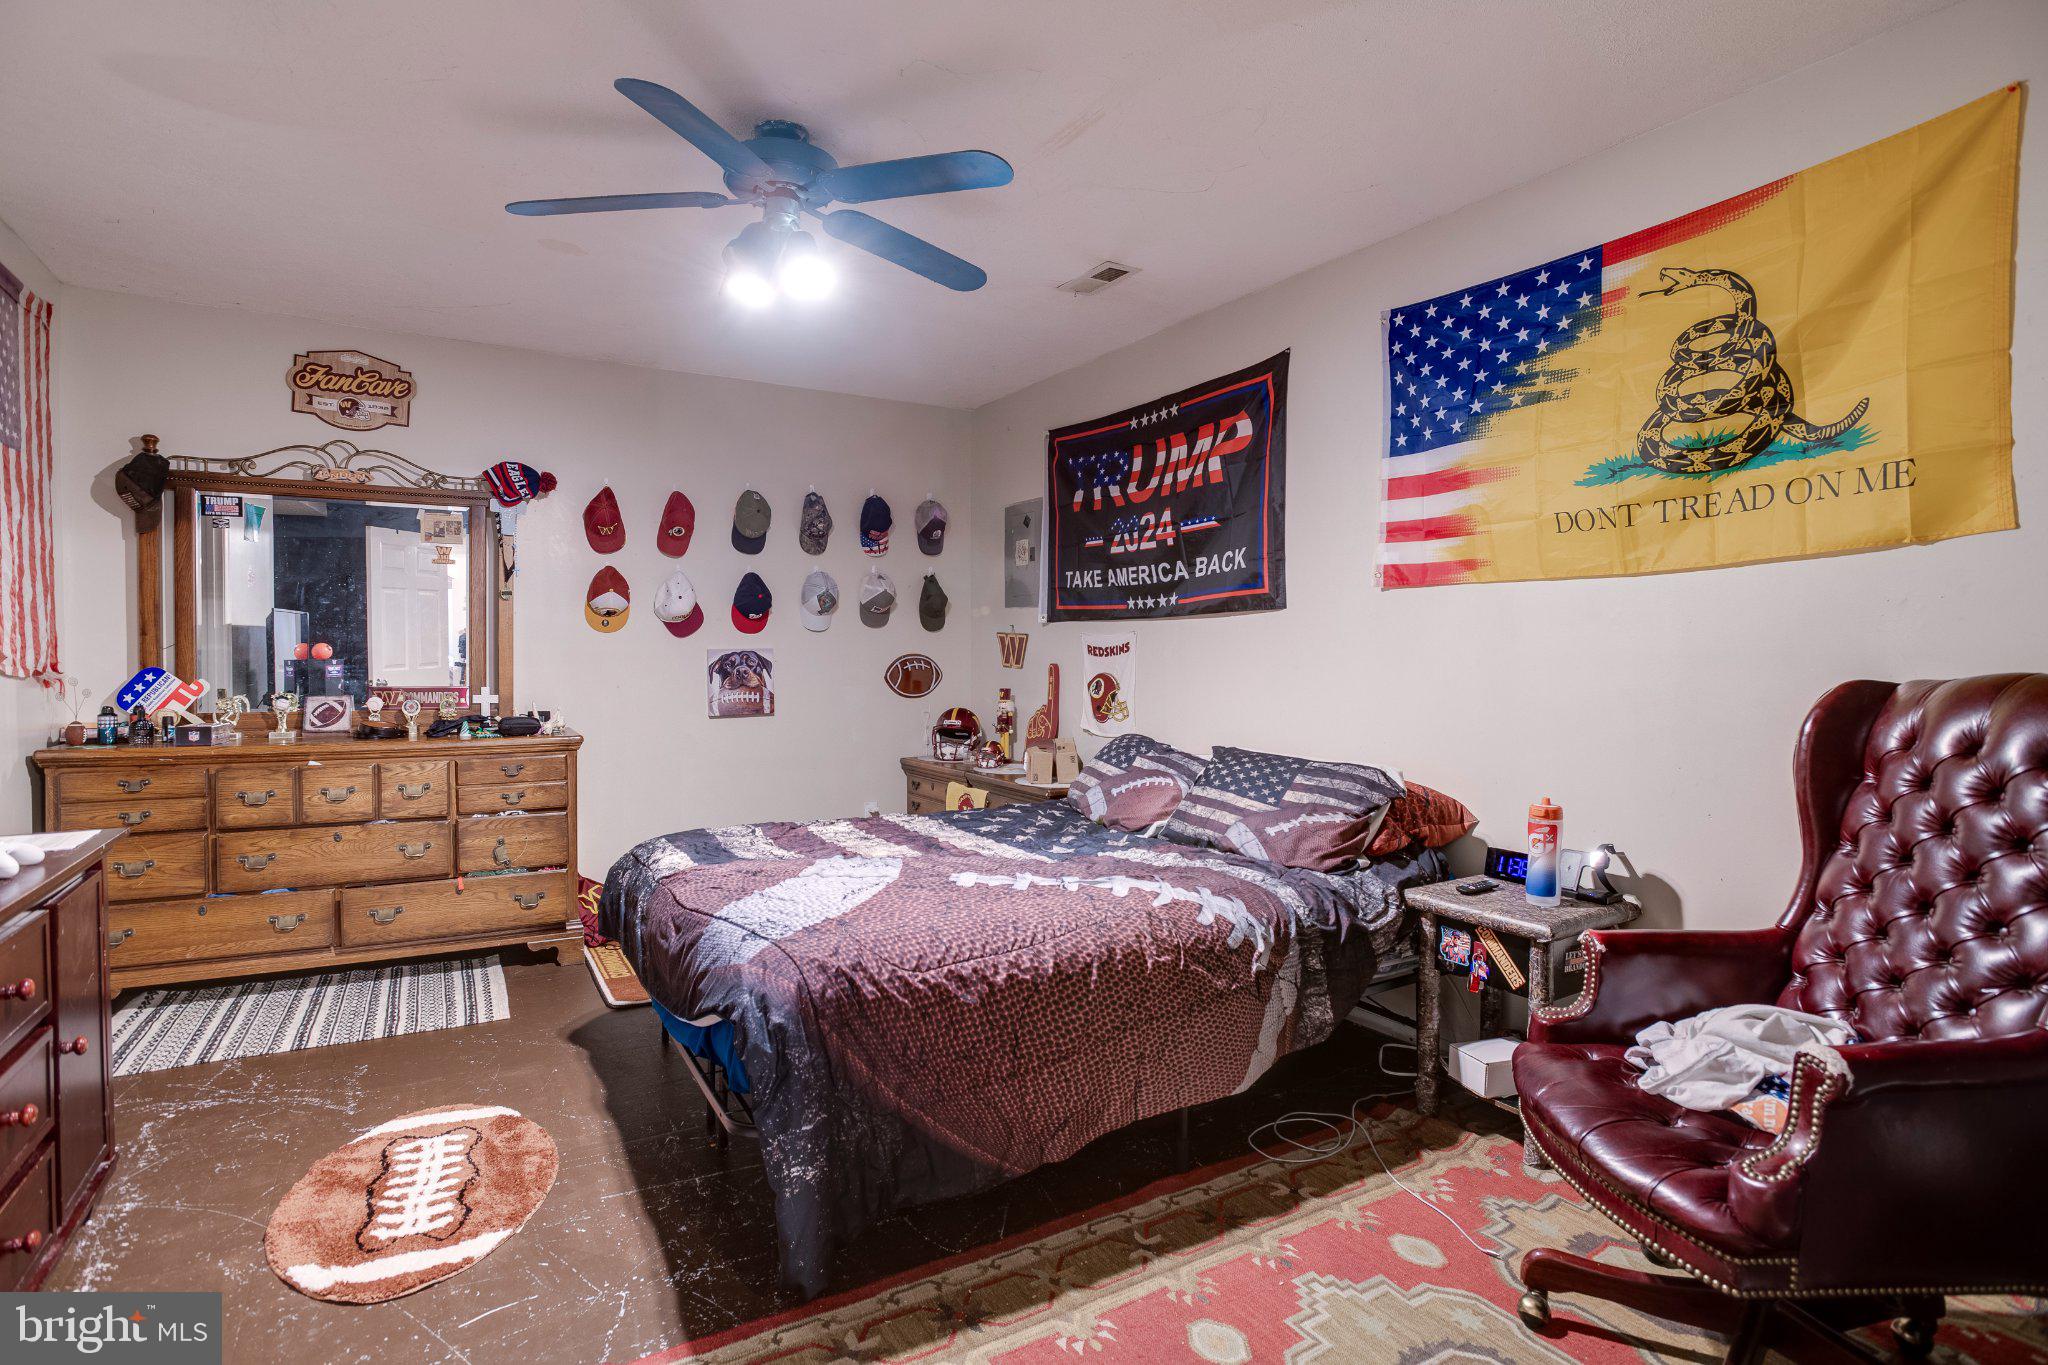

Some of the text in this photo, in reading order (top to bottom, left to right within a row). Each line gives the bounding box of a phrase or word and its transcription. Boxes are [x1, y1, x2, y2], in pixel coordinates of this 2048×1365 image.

[1068, 409, 1254, 513] TRUMP
[204, 495, 239, 506] TRUMP
[1553, 458, 1917, 534] DONT TREAD ON ME
[1110, 507, 1177, 554] 2024
[1065, 547, 1248, 589] TAKE AMERICA BACK
[1087, 641, 1131, 658] REDSKINS
[1477, 925, 1523, 987] COMMANDERS
